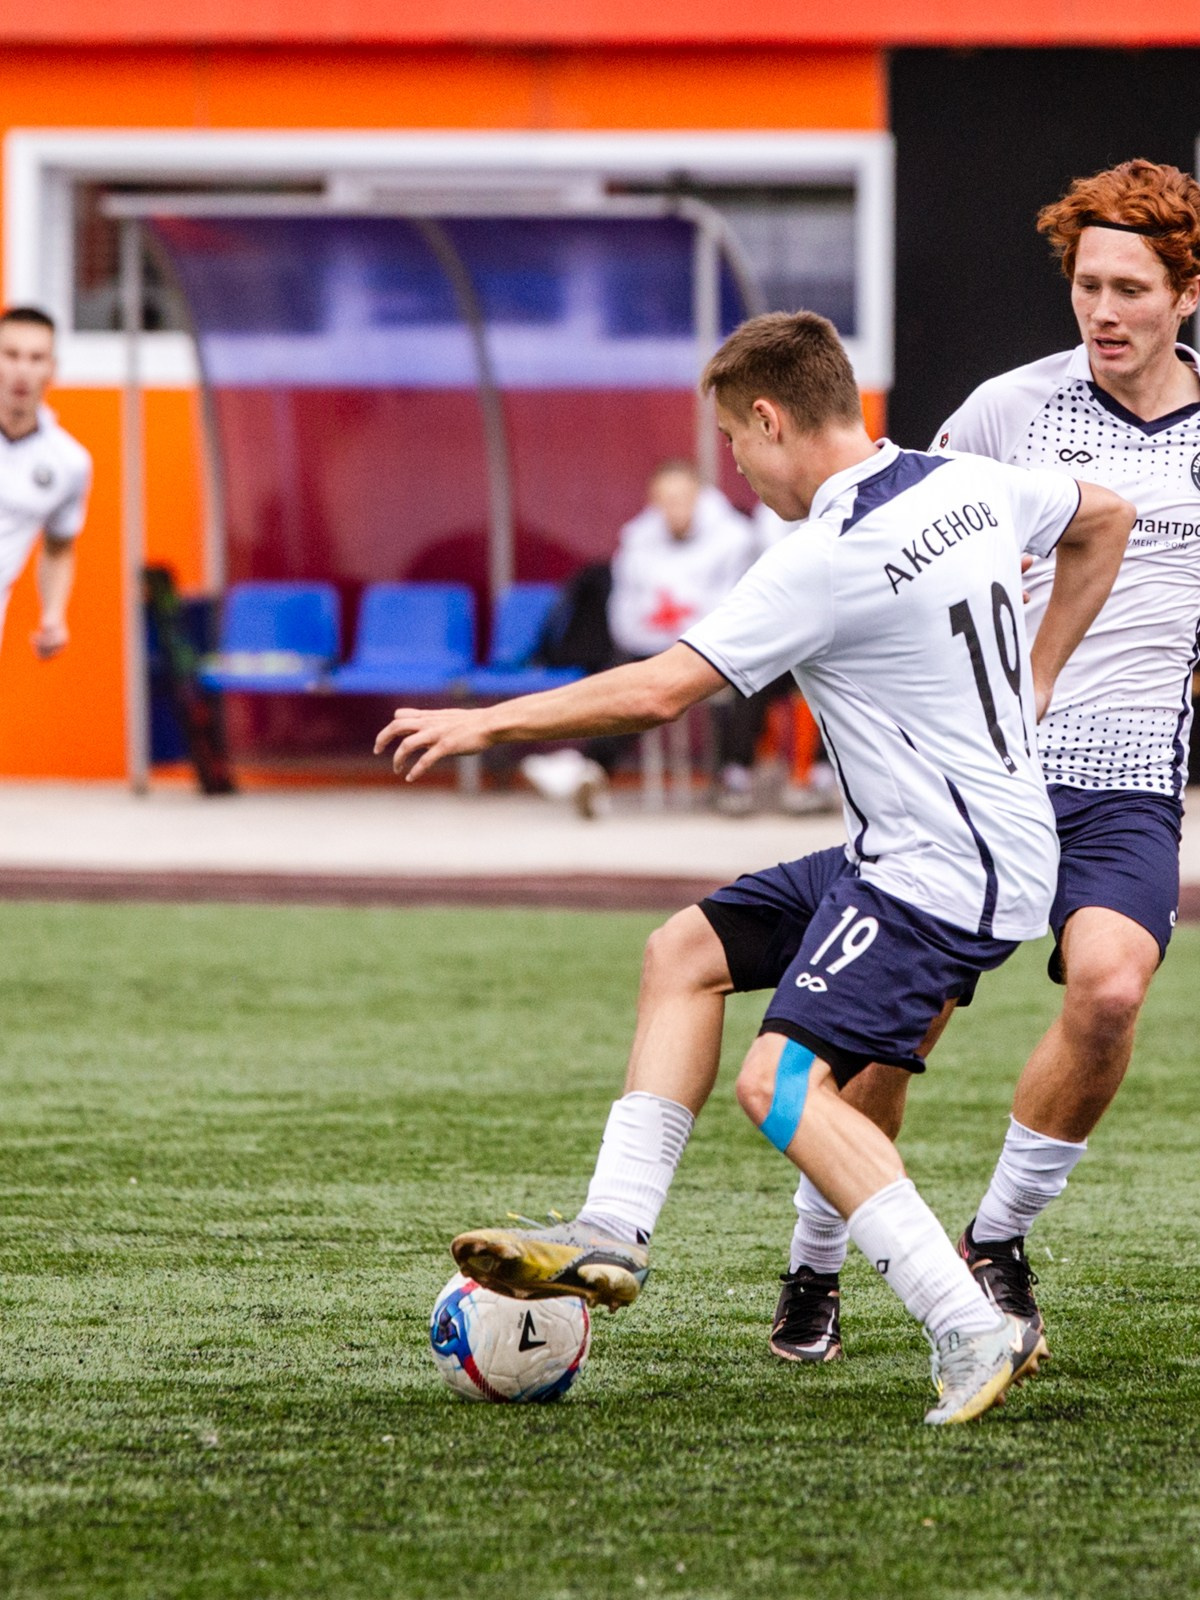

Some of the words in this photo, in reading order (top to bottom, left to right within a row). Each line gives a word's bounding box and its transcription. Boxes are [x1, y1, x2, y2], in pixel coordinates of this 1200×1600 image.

[883, 502, 998, 595] АКСЕНОВ
[949, 581, 1031, 775] 19
[809, 905, 880, 976] 19
